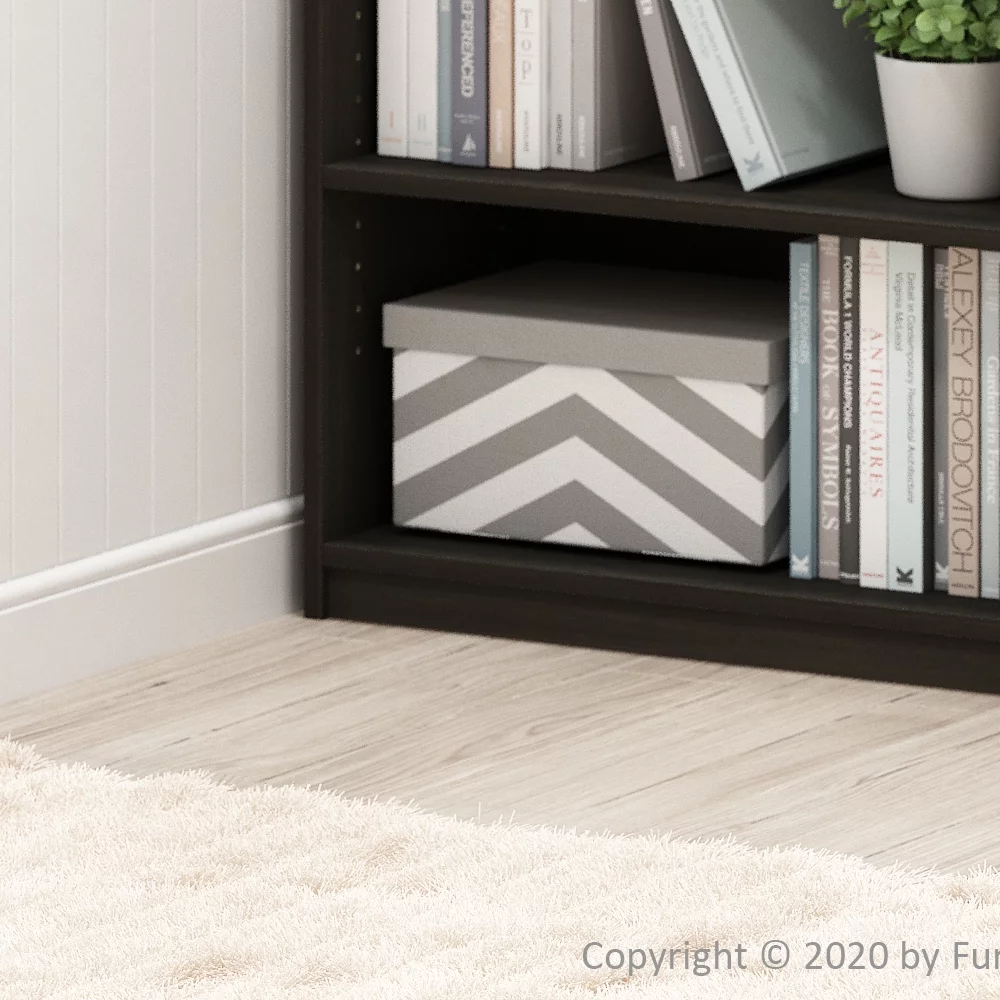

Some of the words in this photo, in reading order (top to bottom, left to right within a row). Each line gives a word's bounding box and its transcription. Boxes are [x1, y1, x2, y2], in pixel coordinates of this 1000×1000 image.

[821, 279, 832, 302] THE
[843, 255, 854, 309] FORMULA
[907, 272, 917, 301] Detail
[950, 248, 974, 366] ALEXEY
[821, 308, 839, 380] BOOK
[843, 319, 854, 361] WORLD
[904, 314, 917, 386] Contemporary
[843, 362, 854, 429] CHAMPIONS
[867, 328, 885, 500] ANTIQUAIRES
[906, 387, 917, 443] Residential
[985, 355, 999, 421] Gardens
[985, 427, 999, 444] in
[821, 406, 839, 531] SYMBOLS
[906, 444, 917, 504] Architecture
[950, 376, 974, 574] BRODOVITCH
[985, 448, 999, 505] France
